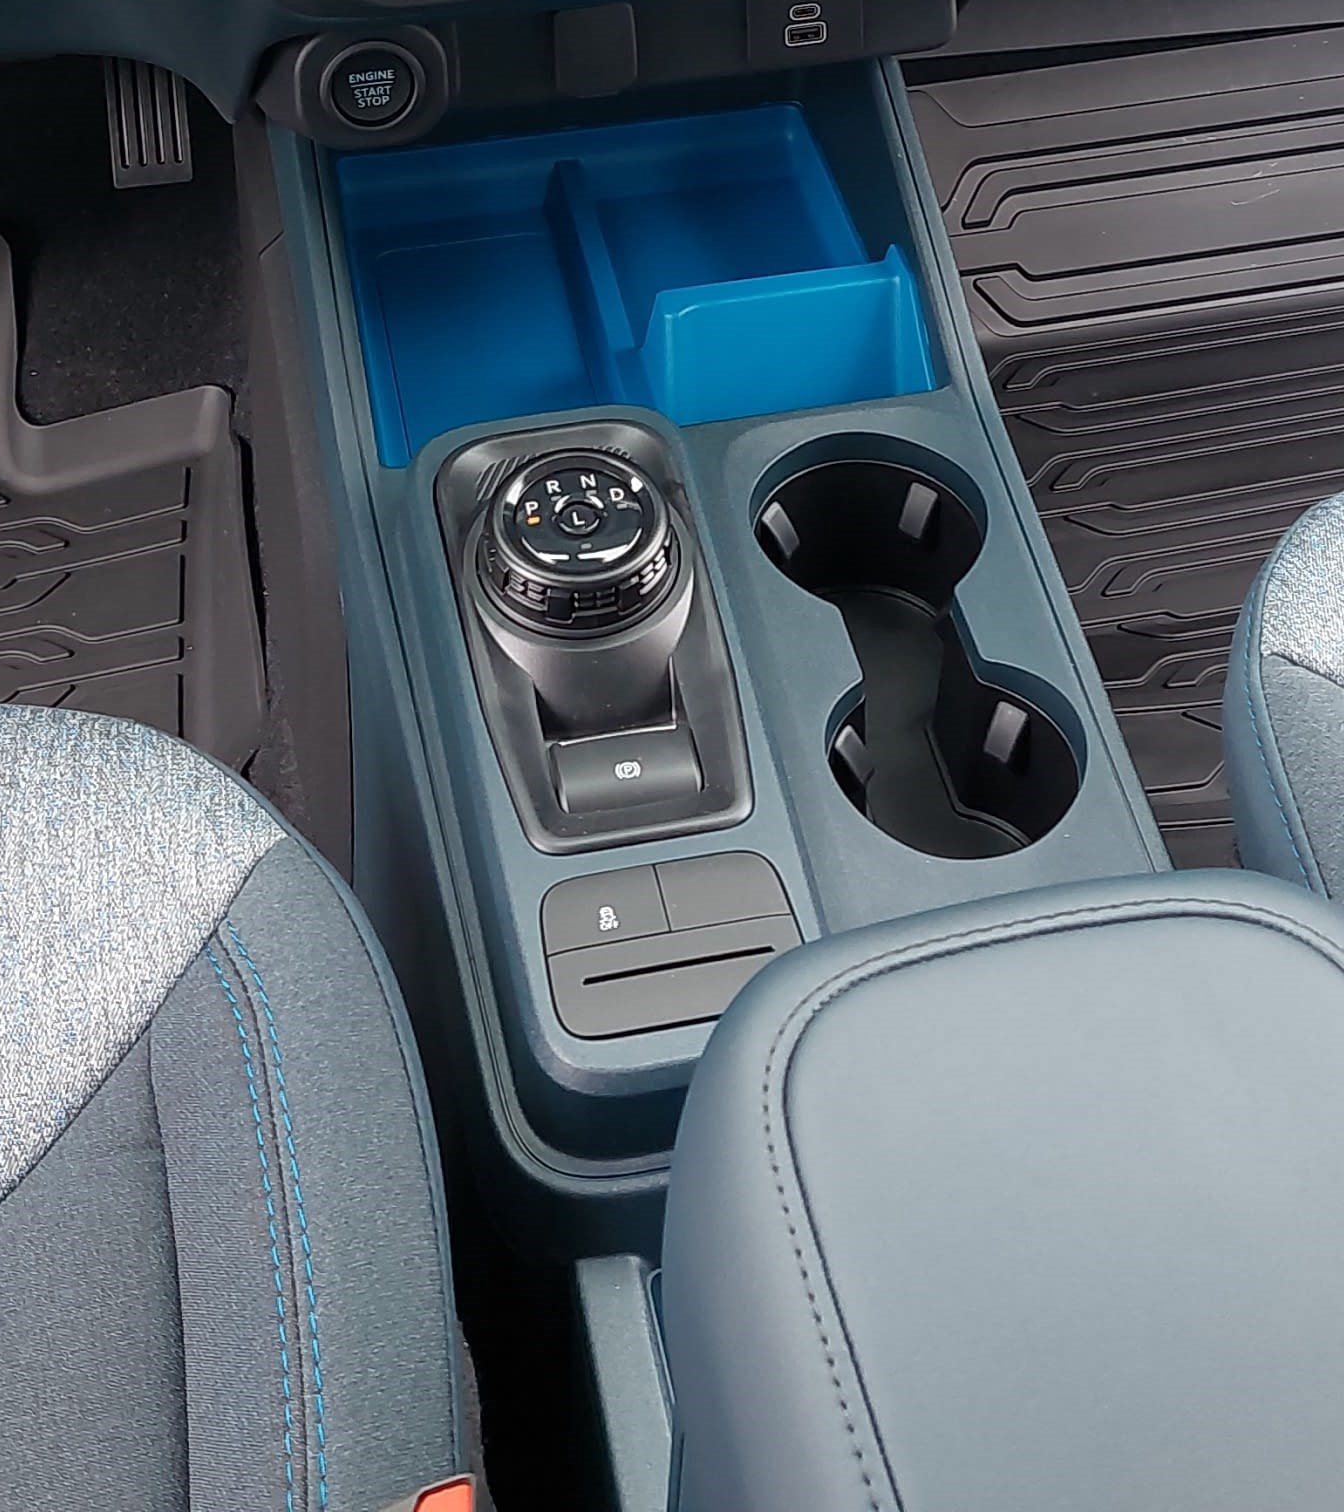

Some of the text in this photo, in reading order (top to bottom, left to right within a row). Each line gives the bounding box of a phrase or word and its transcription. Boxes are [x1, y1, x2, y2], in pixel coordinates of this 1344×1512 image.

[349, 69, 395, 83] ENGINE
[354, 85, 392, 99] START
[357, 96, 390, 108] STOP
[525, 474, 624, 515] P R N D
[572, 511, 586, 526] L
